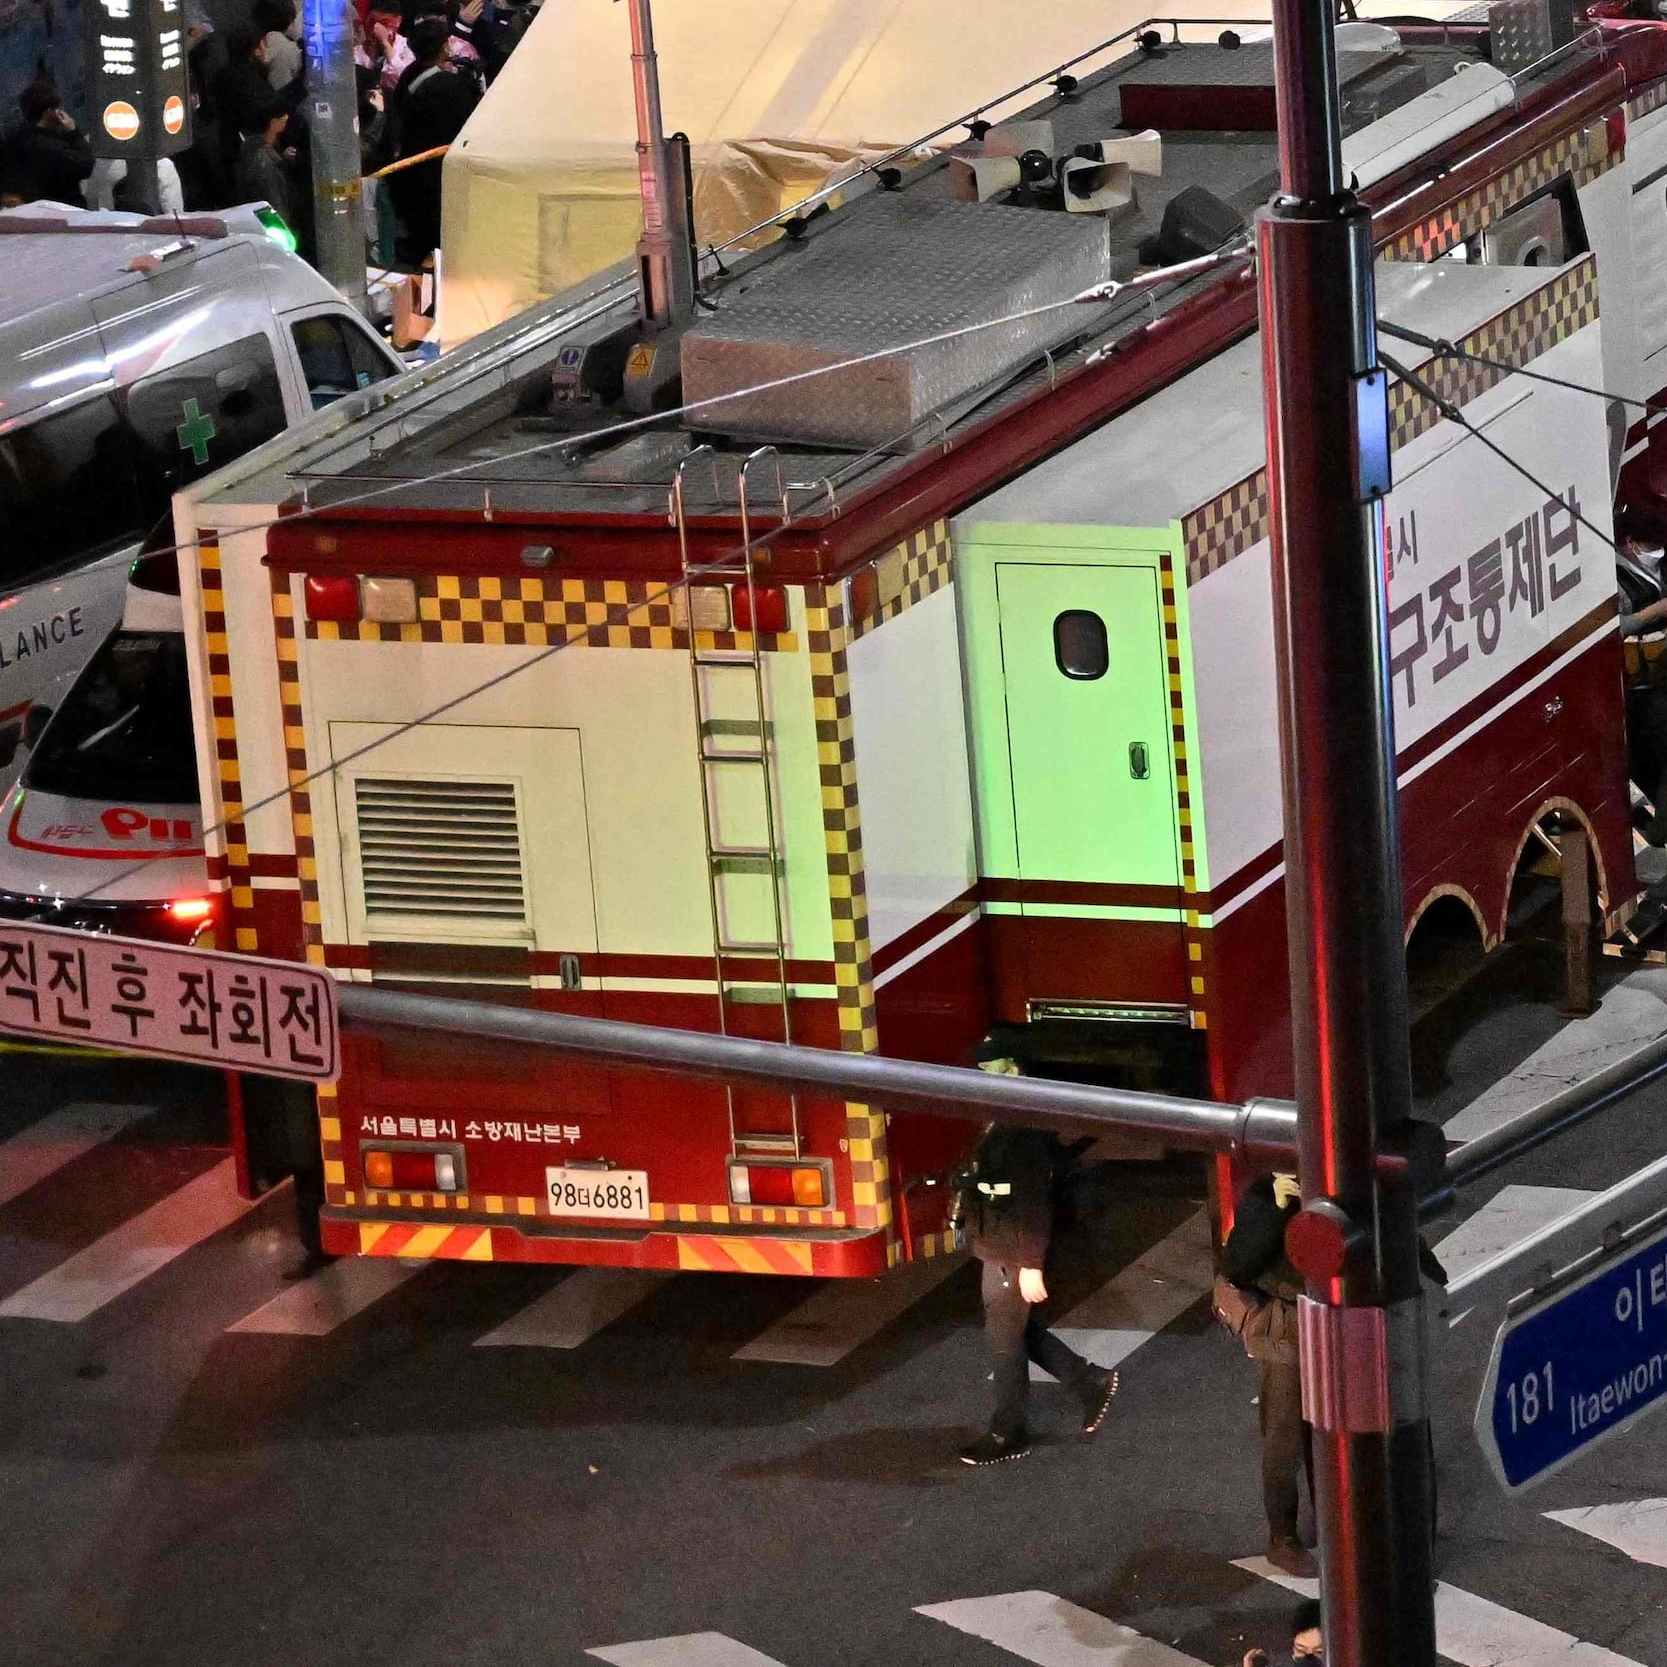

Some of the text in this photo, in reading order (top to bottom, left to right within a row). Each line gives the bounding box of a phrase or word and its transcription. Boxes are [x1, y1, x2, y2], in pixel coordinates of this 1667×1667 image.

[111, 952, 157, 1020] 후
[177, 964, 326, 1068] 좌회전
[361, 1115, 581, 1145] 서울특별시 소방재난본부
[551, 1182, 643, 1210] 98더6881
[1507, 1360, 1555, 1434] 181
